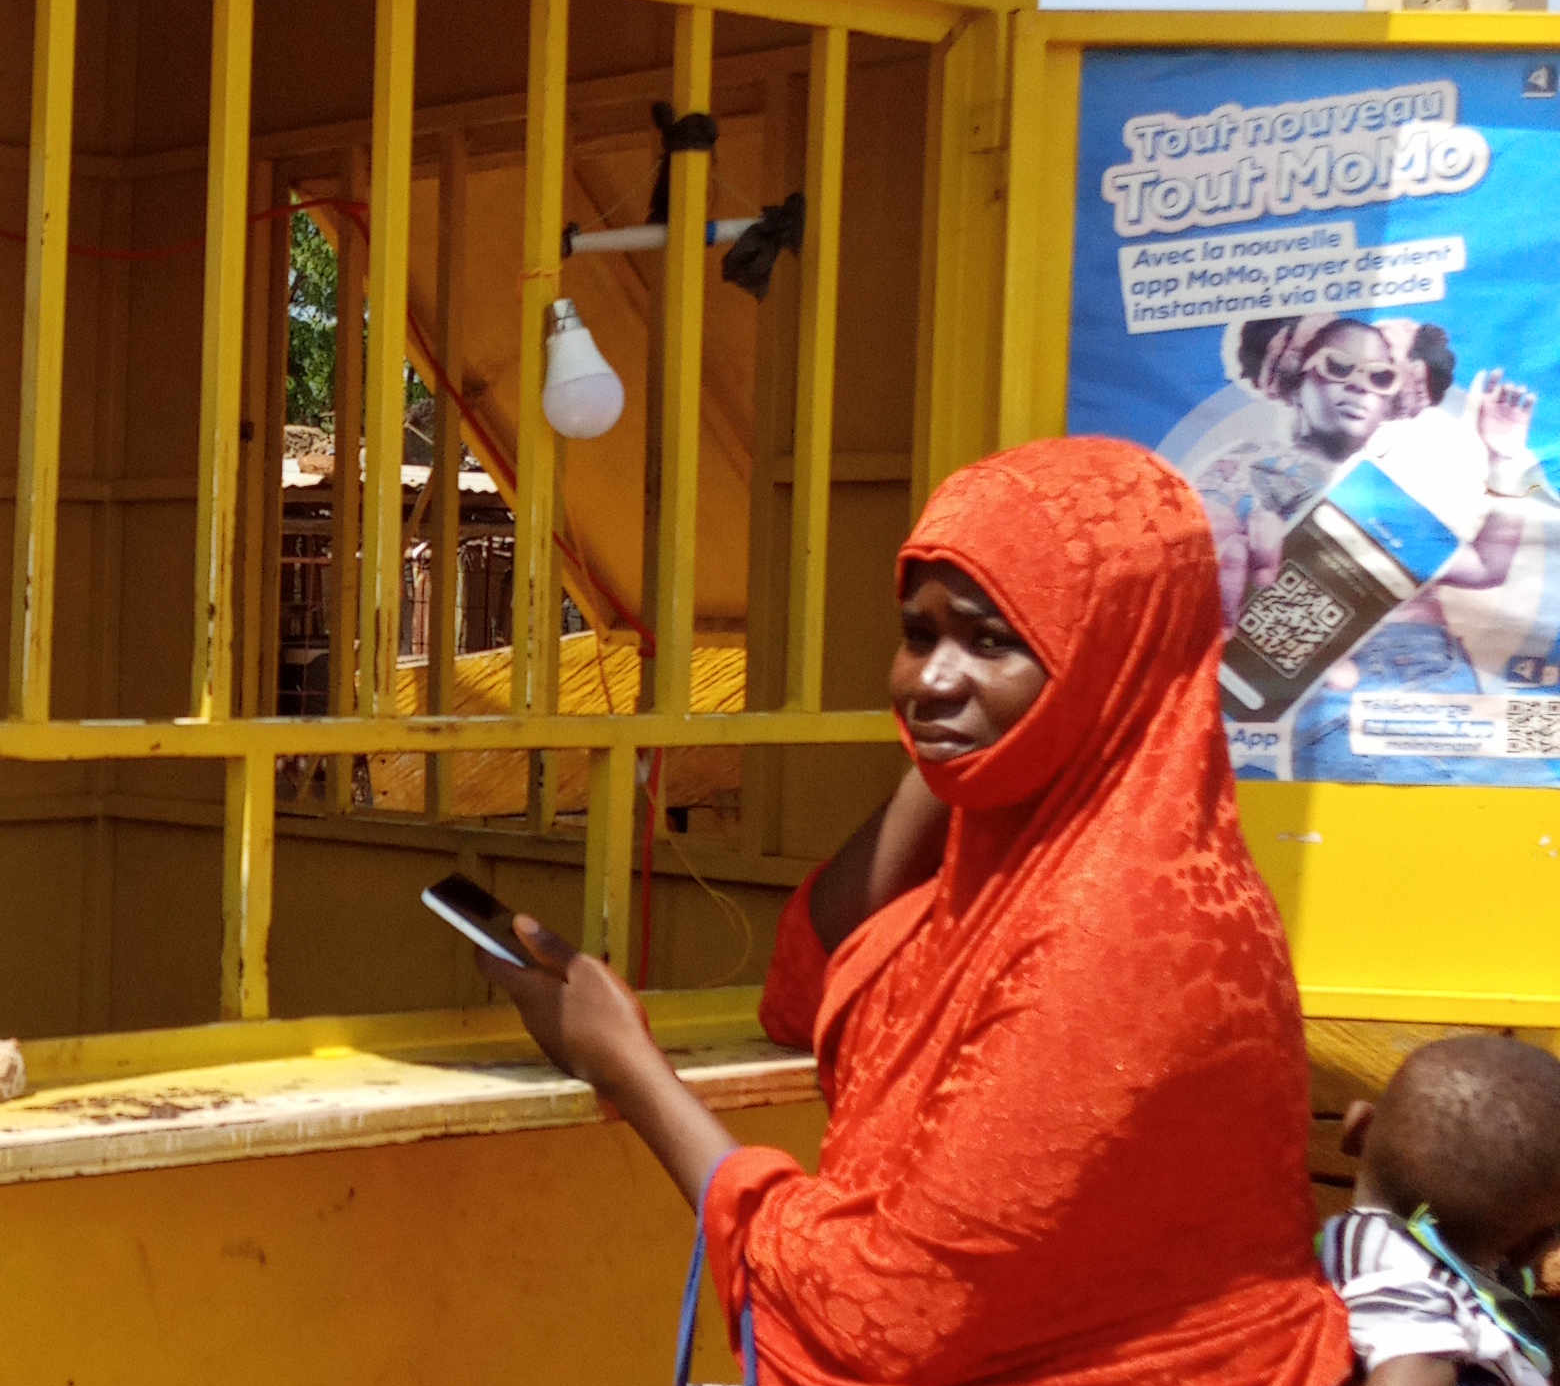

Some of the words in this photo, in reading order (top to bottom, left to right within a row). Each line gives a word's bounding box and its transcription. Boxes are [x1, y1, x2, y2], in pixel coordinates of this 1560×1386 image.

[1132, 113, 1239, 161] Tout
[1241, 87, 1445, 145] nouveau
[1113, 156, 1265, 228] Tout
[1276, 131, 1476, 203] MoMo
[1130, 277, 1179, 298] app
[1186, 265, 1270, 290] MoMo,
[1274, 258, 1350, 286] payer
[1355, 245, 1452, 272] devient
[1132, 248, 1196, 269] Avec
[1202, 241, 1225, 261] la
[1231, 229, 1342, 257] nouvelle
[1132, 287, 1273, 322] instantané
[1279, 285, 1317, 307] via
[1324, 280, 1363, 302] QR
[1369, 274, 1434, 297] code
[1229, 728, 1279, 751] App
